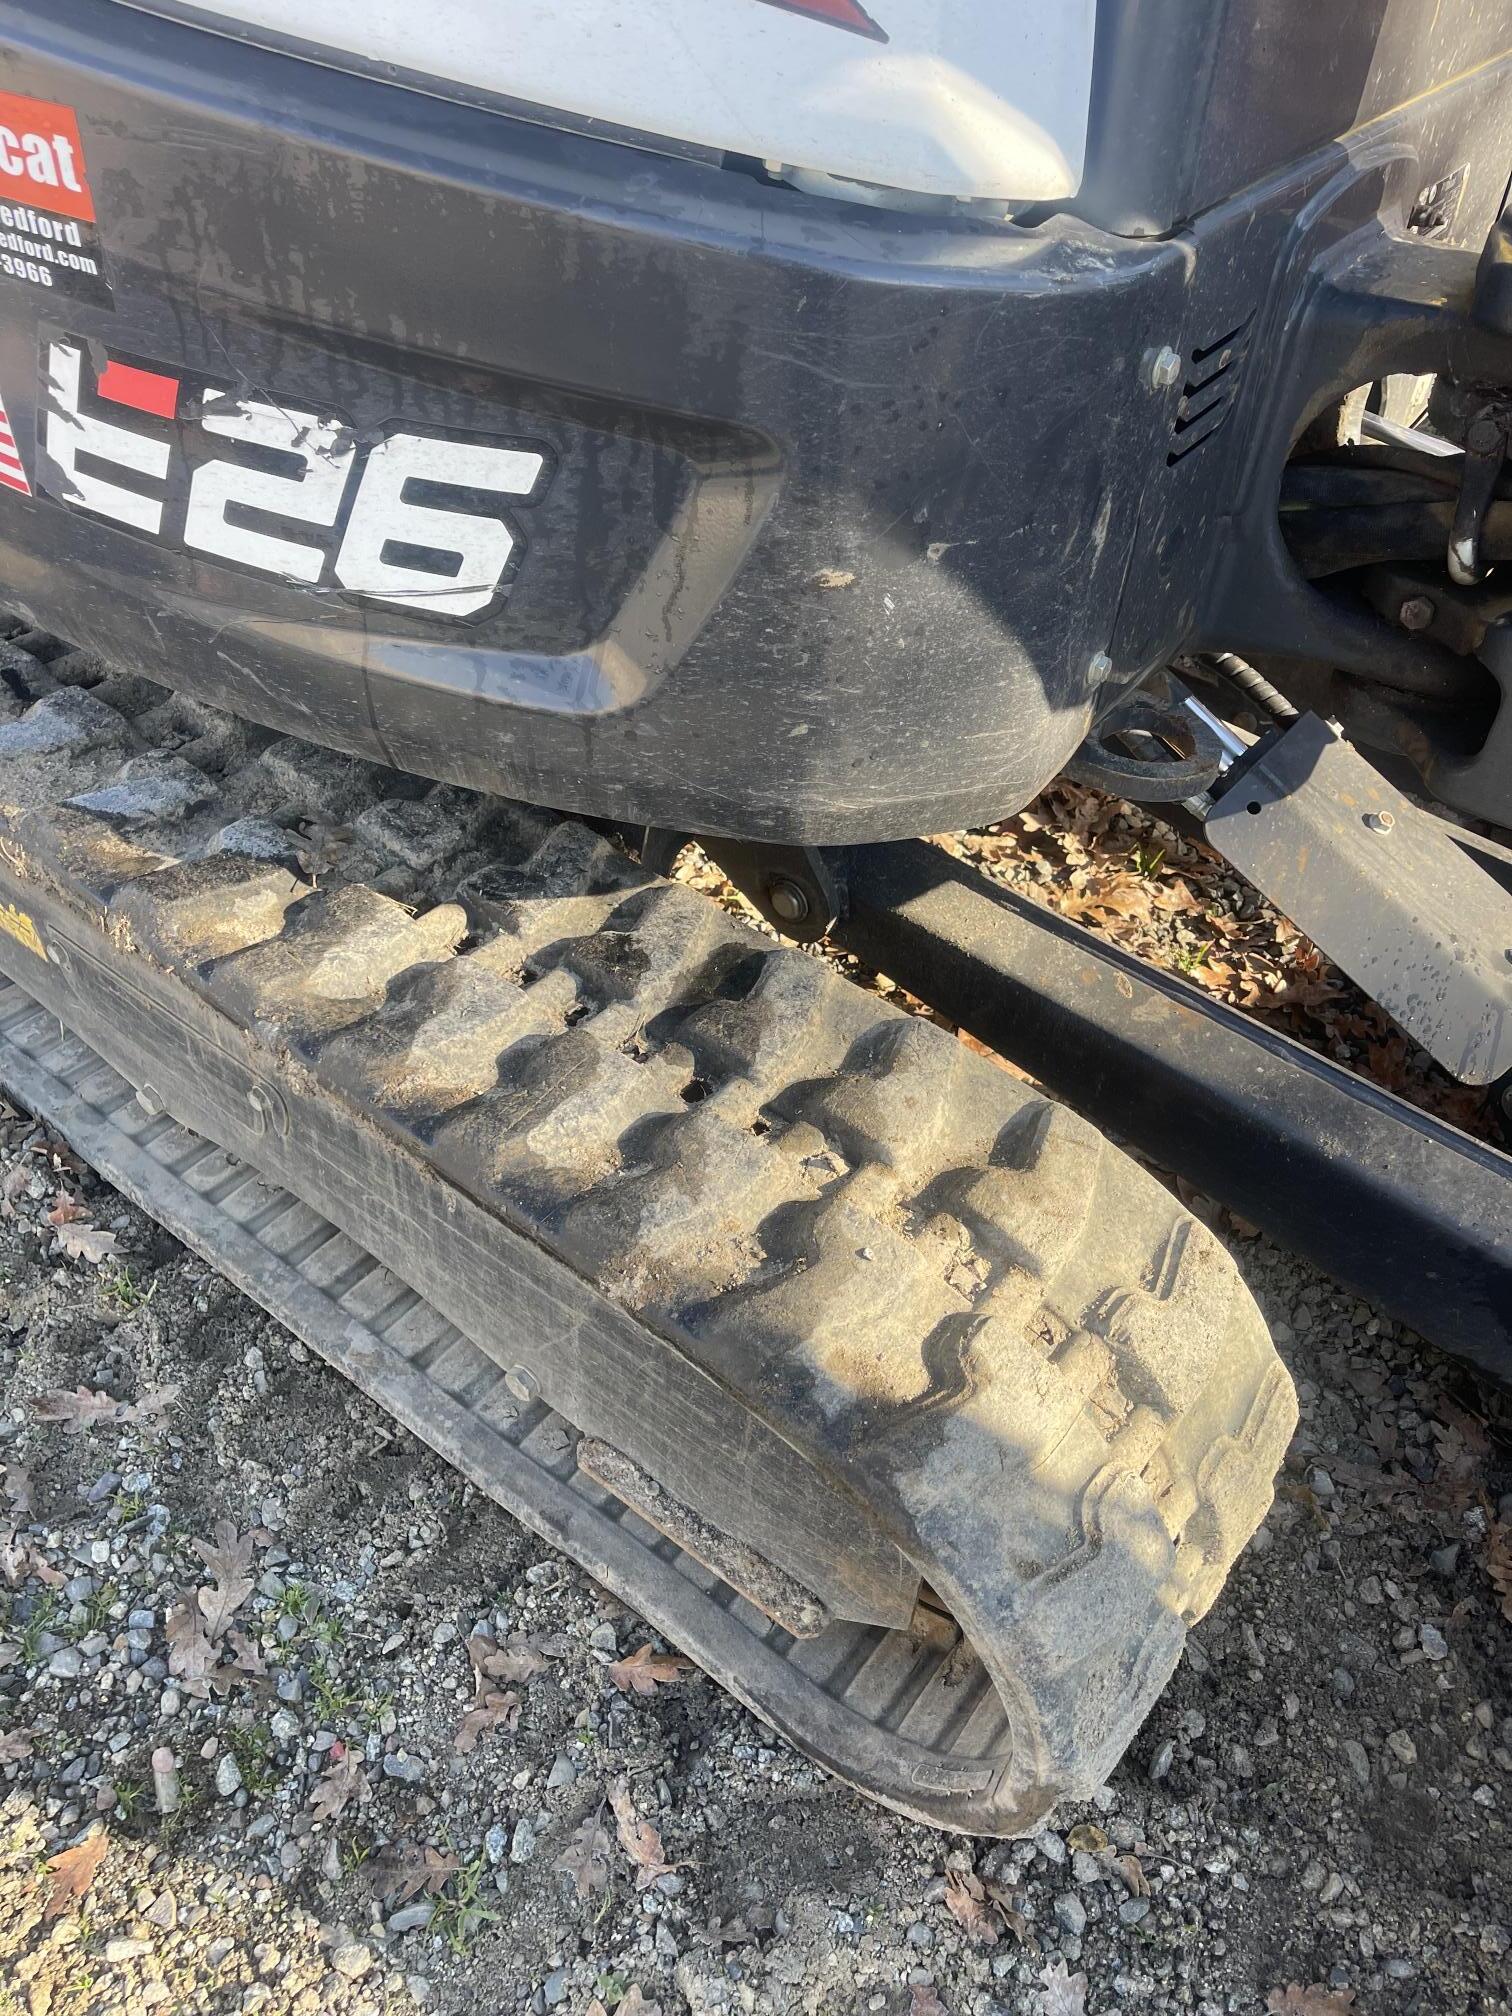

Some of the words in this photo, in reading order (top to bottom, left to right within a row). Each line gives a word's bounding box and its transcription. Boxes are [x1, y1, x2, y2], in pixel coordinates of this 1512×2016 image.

[0, 125, 82, 192] cat
[0, 204, 82, 247] edford
[0, 232, 98, 275] edford.com
[46, 342, 544, 617] E26
